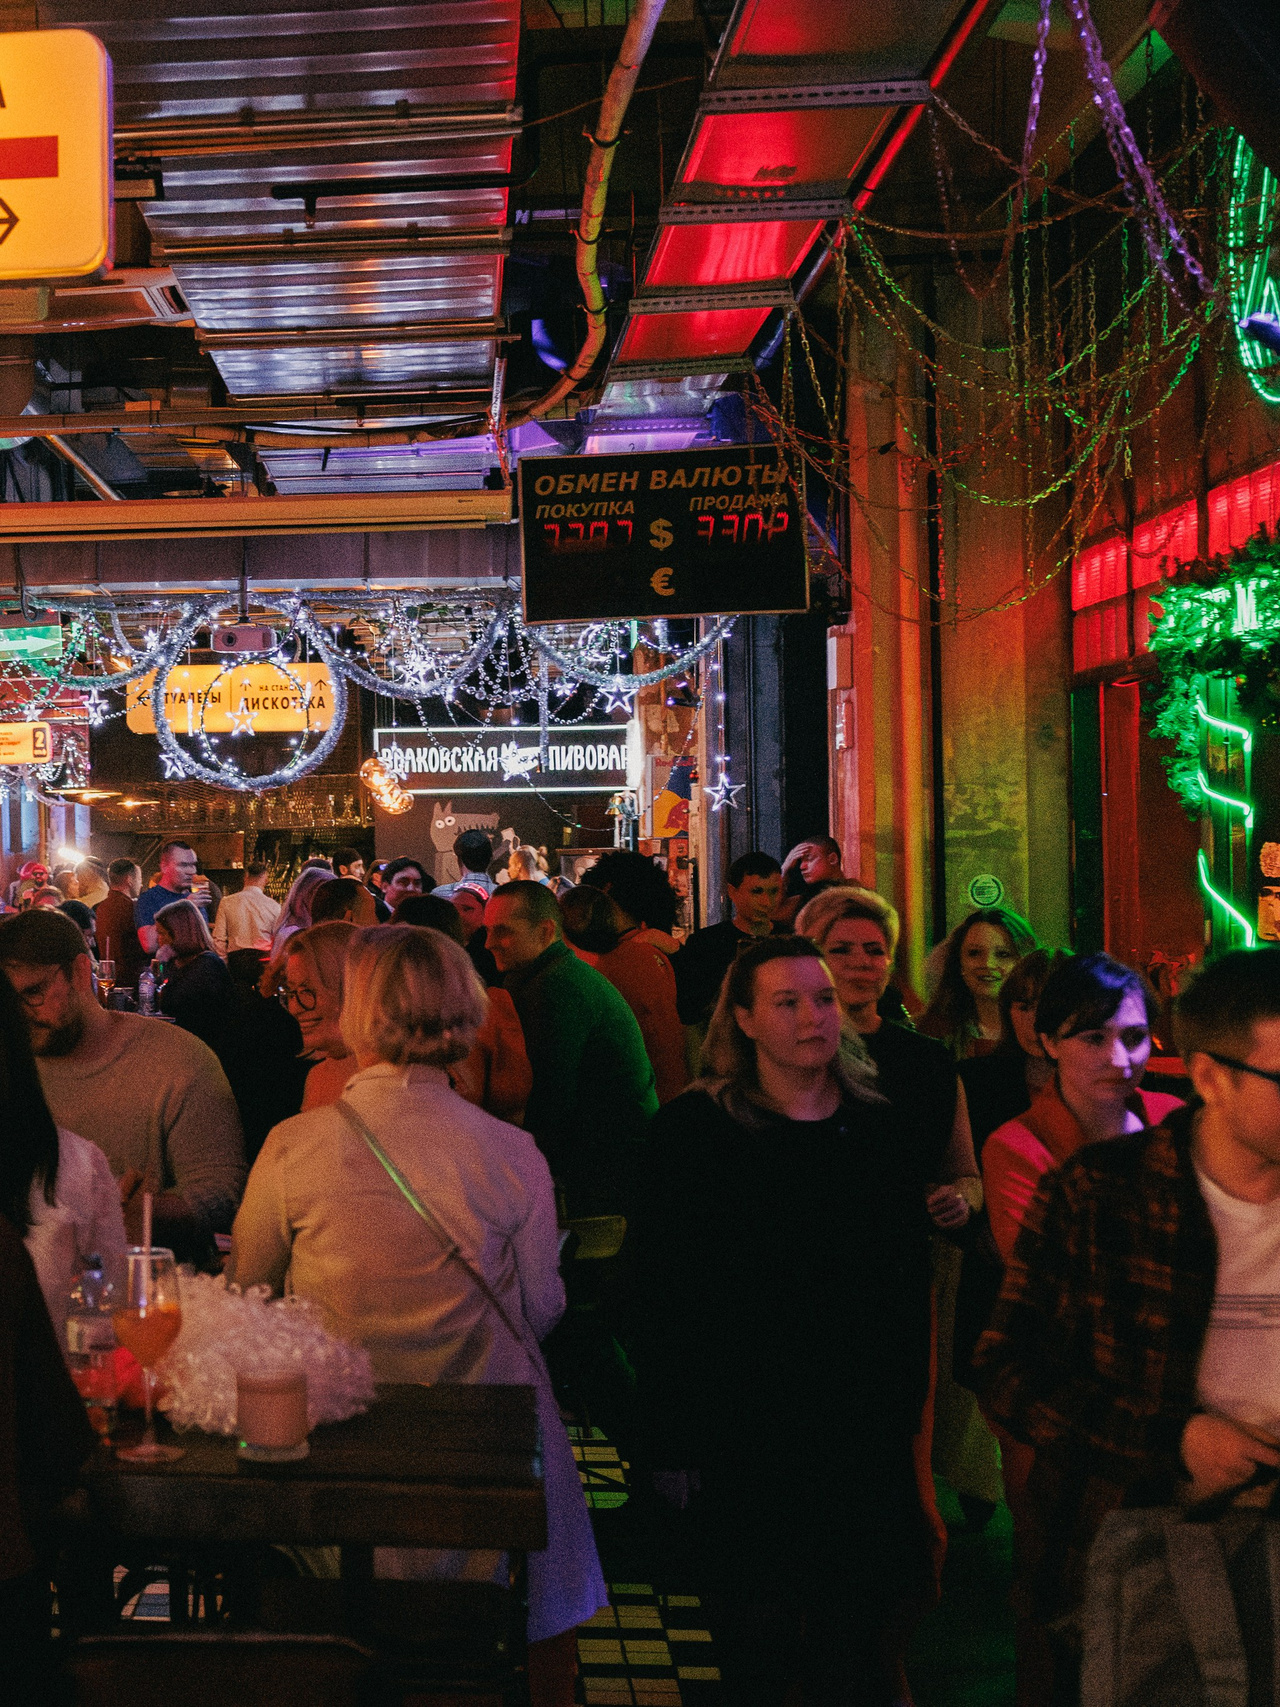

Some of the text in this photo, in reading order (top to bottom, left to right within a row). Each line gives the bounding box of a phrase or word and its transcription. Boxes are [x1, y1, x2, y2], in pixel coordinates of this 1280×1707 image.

[533, 463, 789, 496] ОБМЕН ВАЛЮТЫ
[535, 500, 635, 519] ПОКУПКА
[689, 492, 789, 512] ПРОДАЖА
[649, 518, 674, 551] $
[650, 566, 676, 597] €
[271, 684, 307, 692] СТАН
[163, 692, 221, 704] ТУАЛЕТЫ
[34, 730, 45, 748] 2
